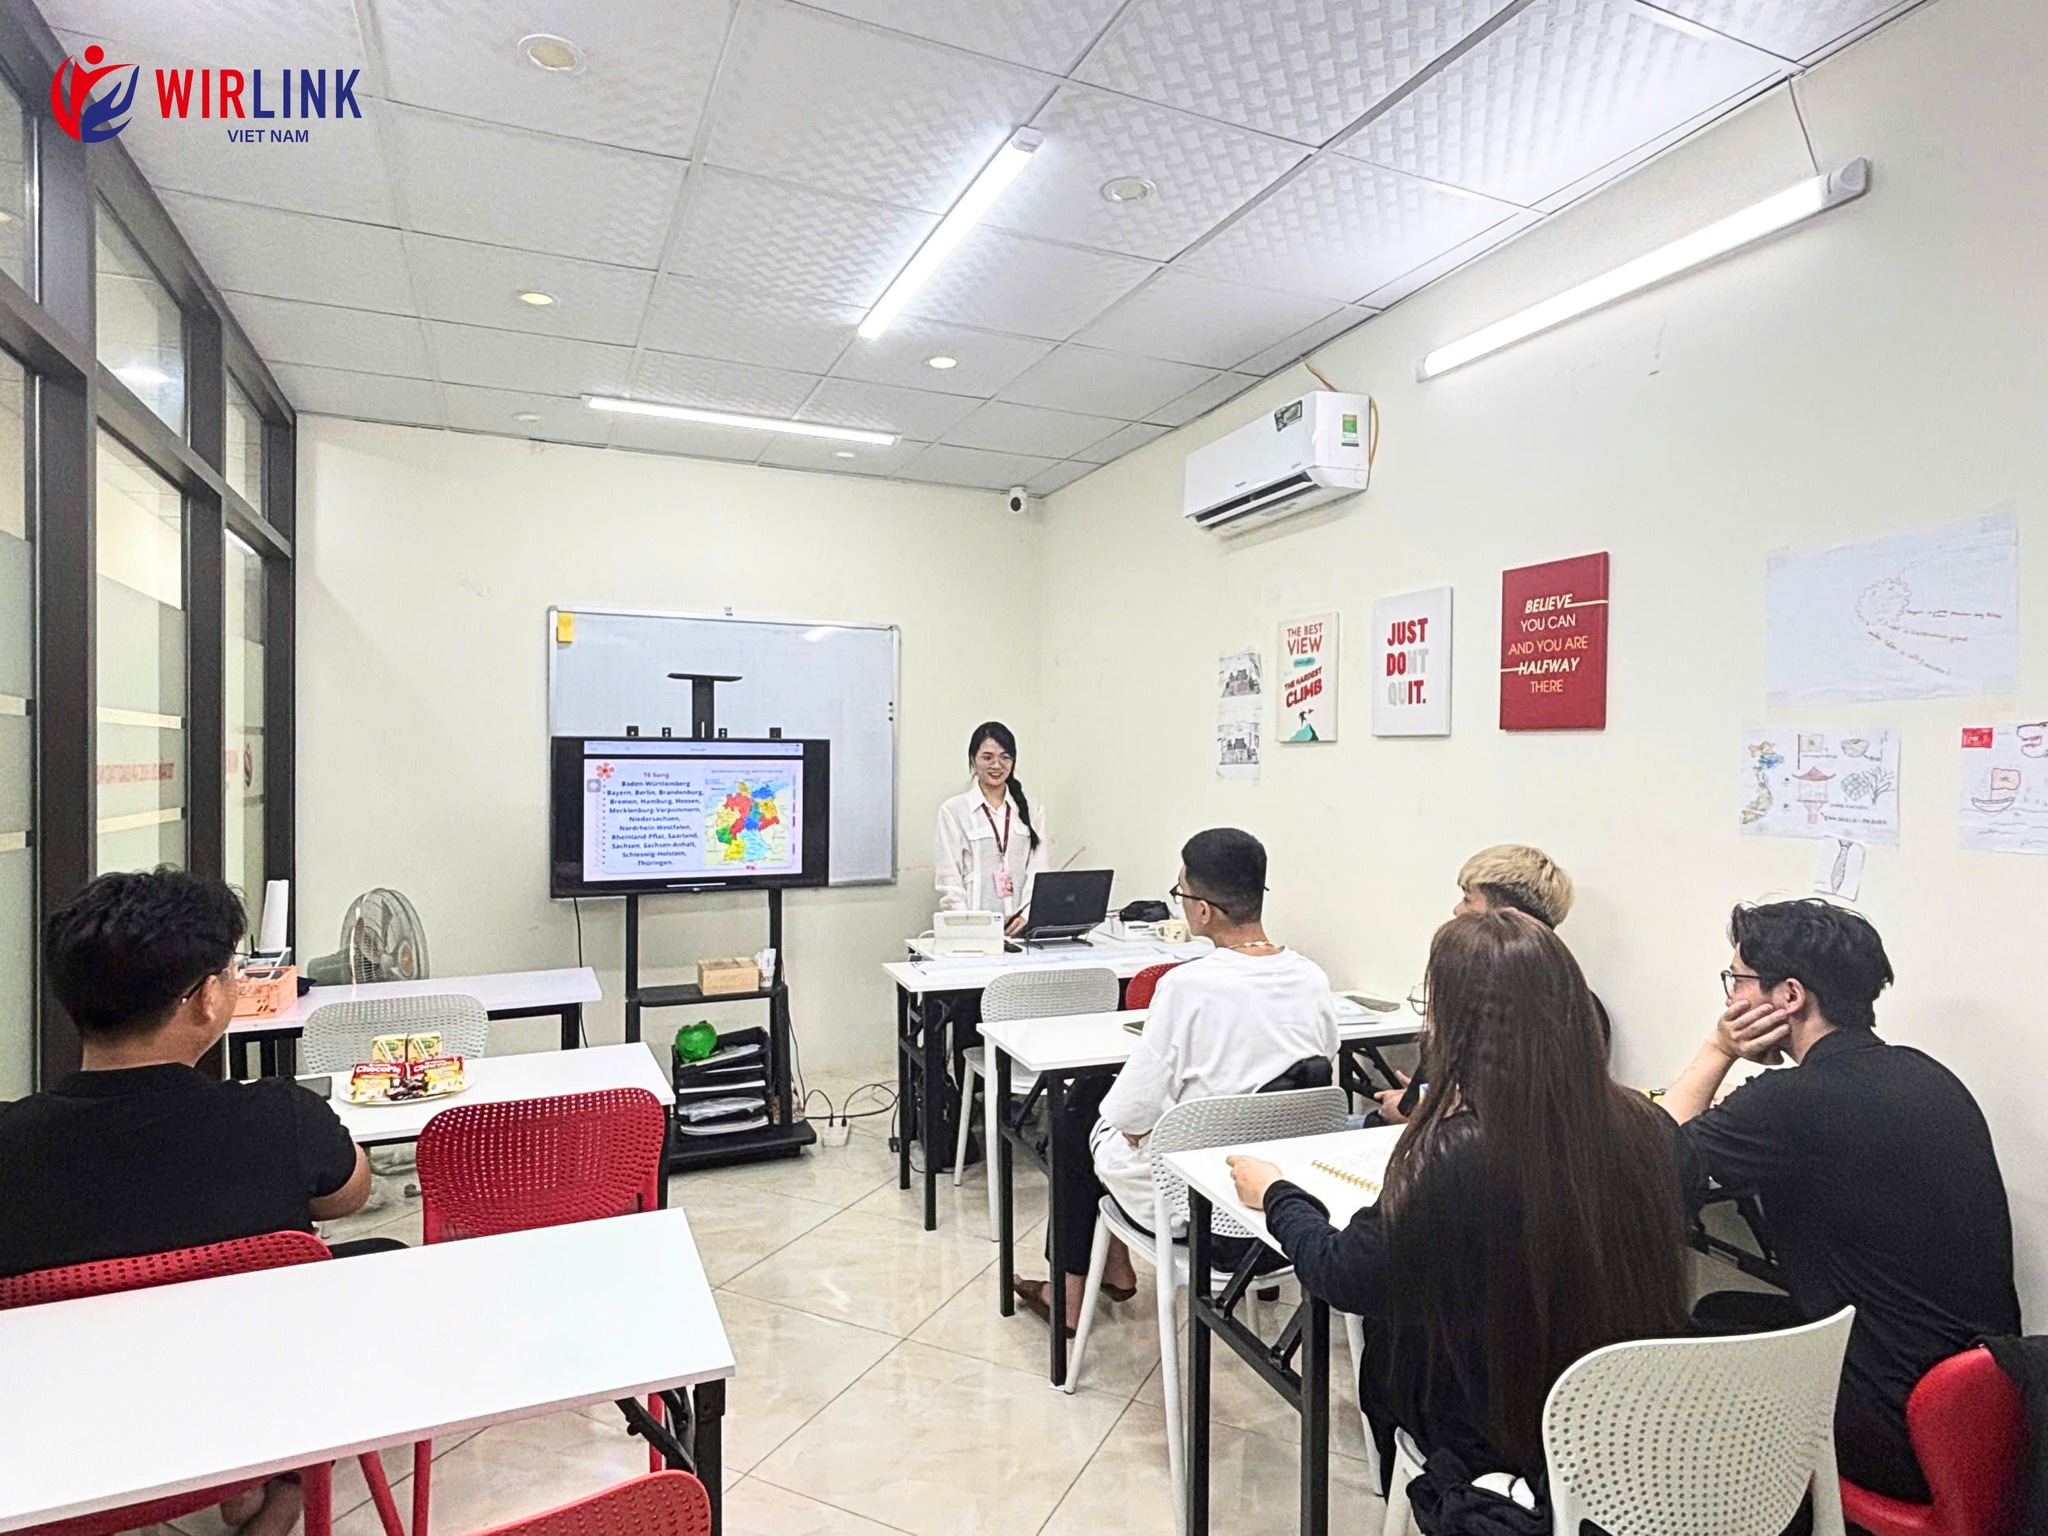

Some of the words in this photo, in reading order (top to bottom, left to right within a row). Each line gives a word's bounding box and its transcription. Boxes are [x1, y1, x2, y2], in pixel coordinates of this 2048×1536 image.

[1525, 593, 1573, 613] BELIEVE
[1287, 626, 1301, 638] THE
[1304, 622, 1323, 635] BEST
[1387, 617, 1428, 646] JUST
[1520, 617, 1545, 632] YOU
[1547, 613, 1576, 629] CAN
[1287, 634, 1323, 656] VIEW
[1508, 641, 1534, 655] AND
[1536, 638, 1562, 652] YOU
[1564, 635, 1589, 650] ARE
[1386, 648, 1429, 676] DONT
[1518, 657, 1580, 675] HALFWAY
[1284, 680, 1295, 691] THE
[1296, 666, 1322, 685] HARDEST
[1531, 679, 1563, 693] THERE
[1286, 678, 1323, 708] CLIMB
[1387, 679, 1426, 706] QUIT.
